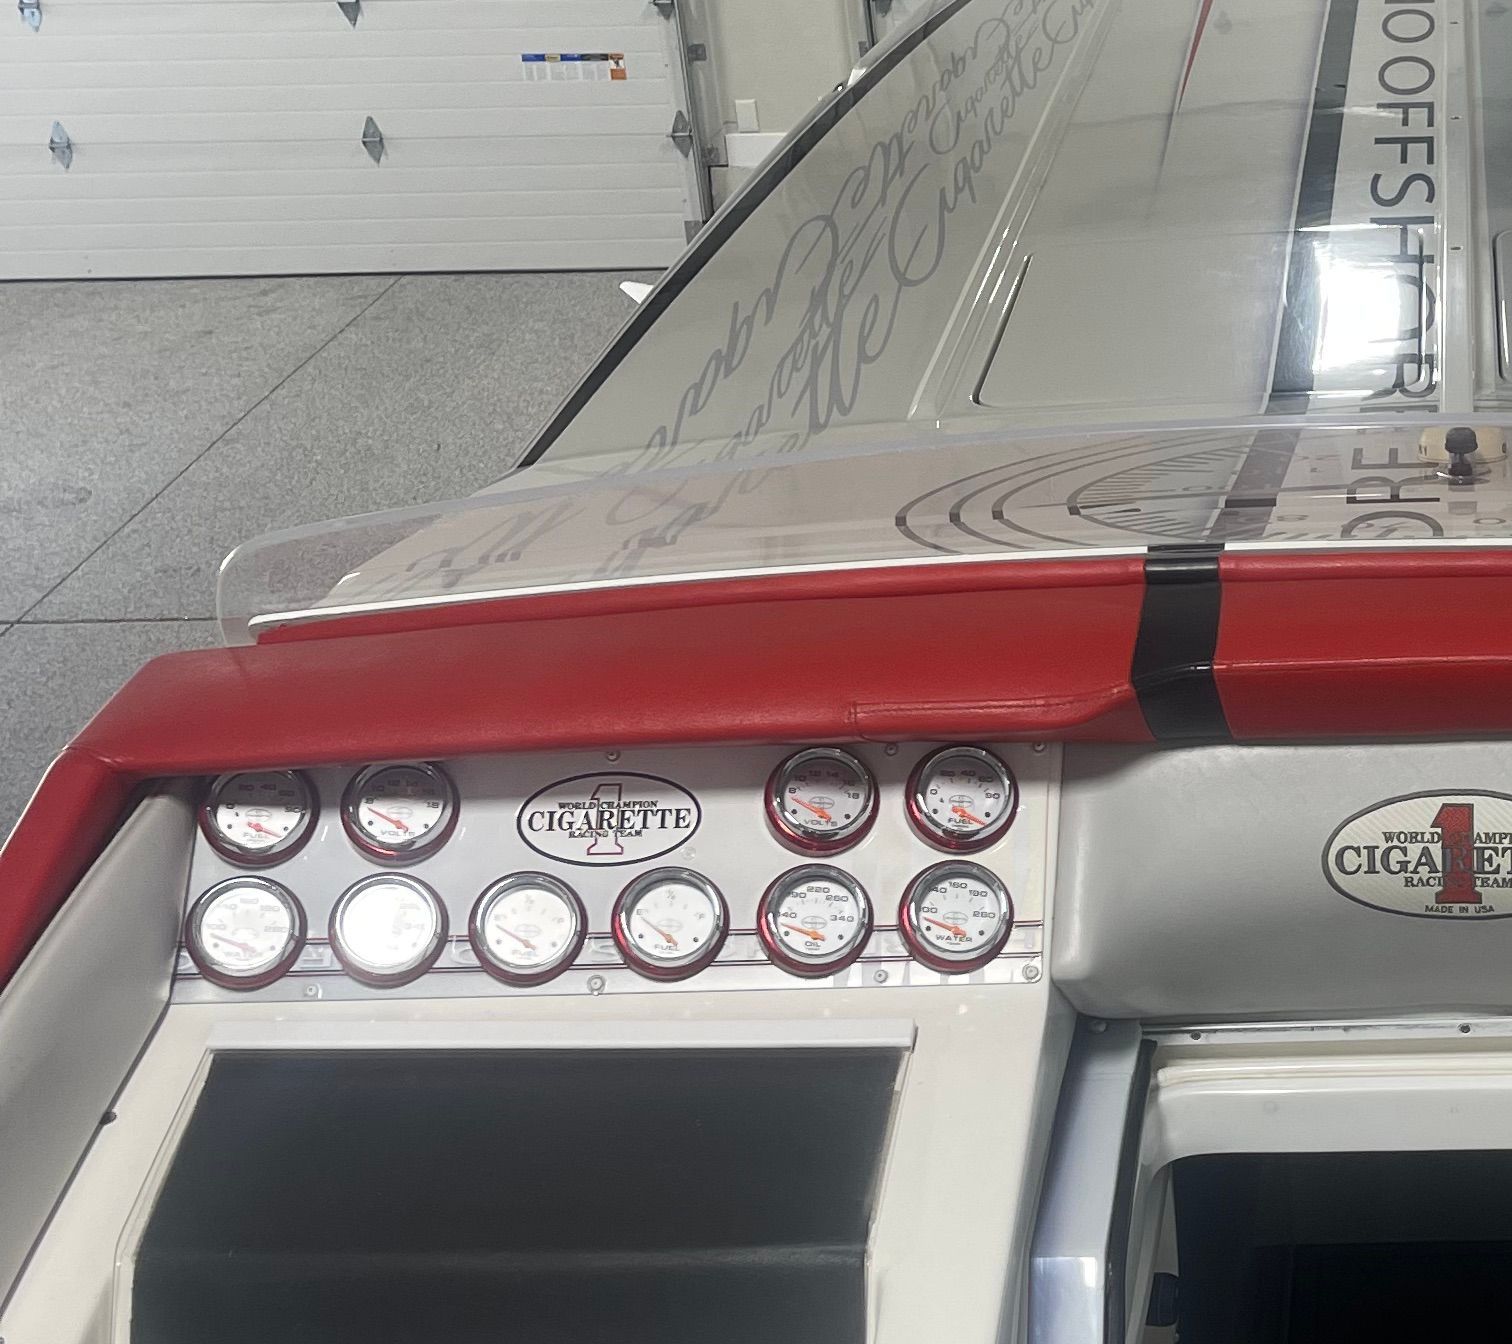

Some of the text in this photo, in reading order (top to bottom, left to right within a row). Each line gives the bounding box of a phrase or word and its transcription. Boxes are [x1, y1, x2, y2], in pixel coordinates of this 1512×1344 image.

[528, 808, 691, 831] CIGARETTE
[806, 886, 830, 894] 220
[1424, 905, 1494, 914] MADE IN USA
[936, 935, 972, 943] WATER
